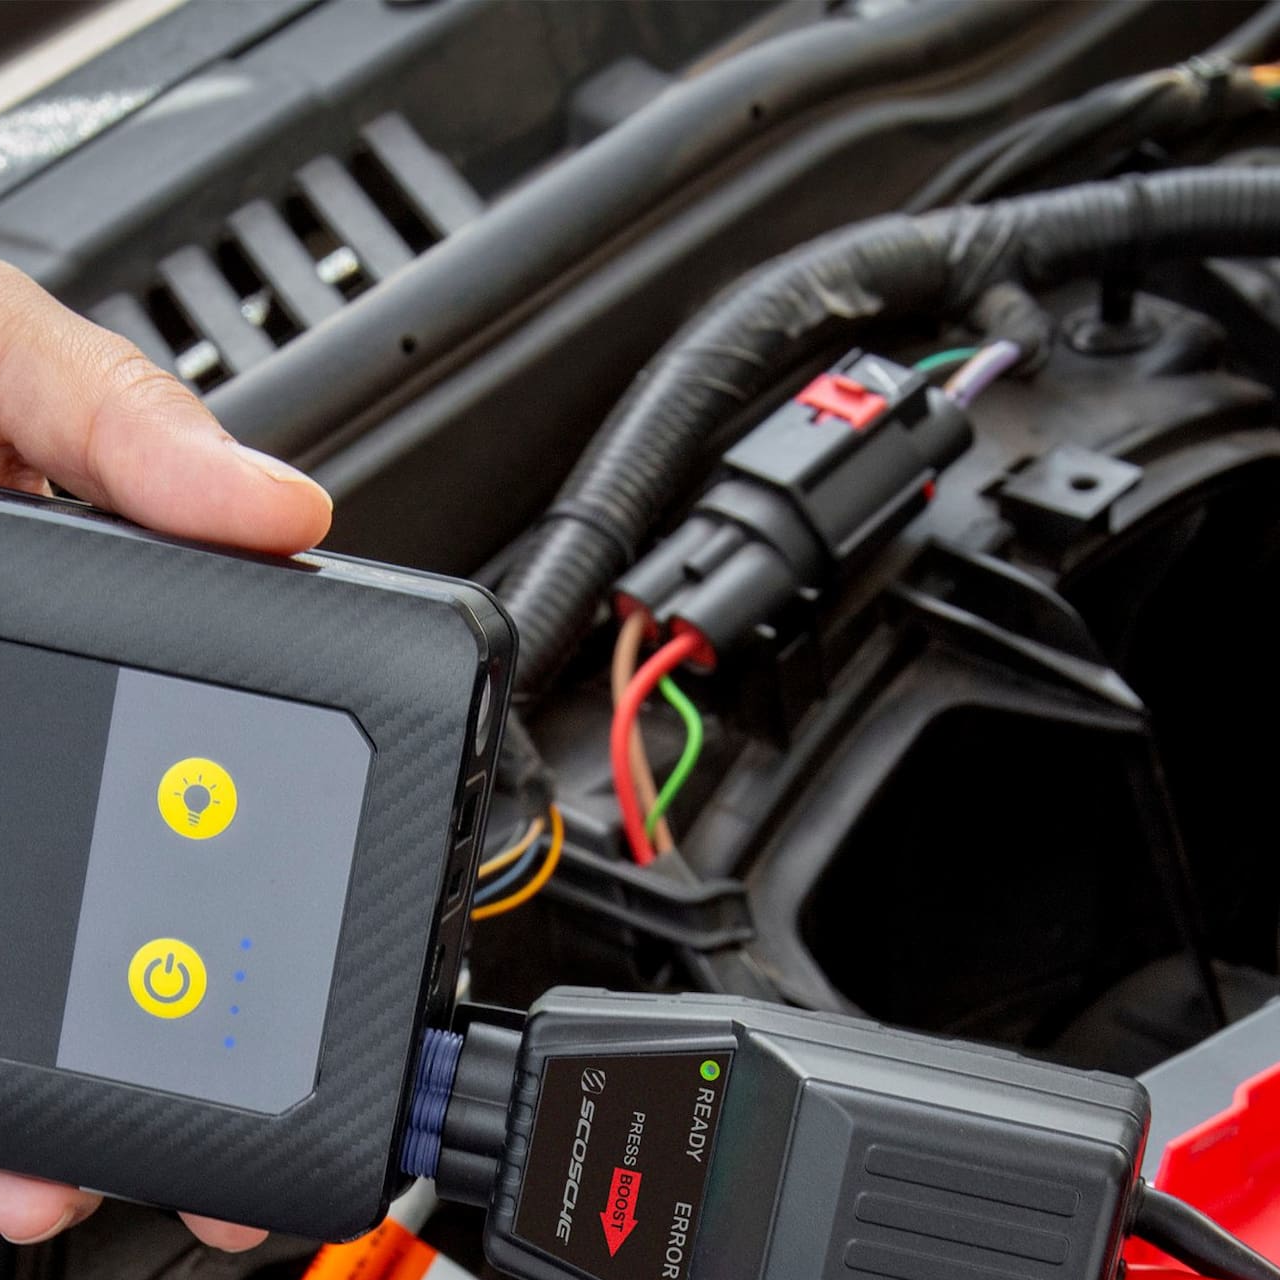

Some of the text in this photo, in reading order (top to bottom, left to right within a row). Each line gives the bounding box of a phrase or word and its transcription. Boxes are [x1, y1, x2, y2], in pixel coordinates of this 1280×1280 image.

[555, 1095, 596, 1246] SCOSCHE
[610, 1110, 646, 1232] PRESS BOOST
[686, 1086, 715, 1163] READY
[661, 1201, 693, 1280] ERROR
